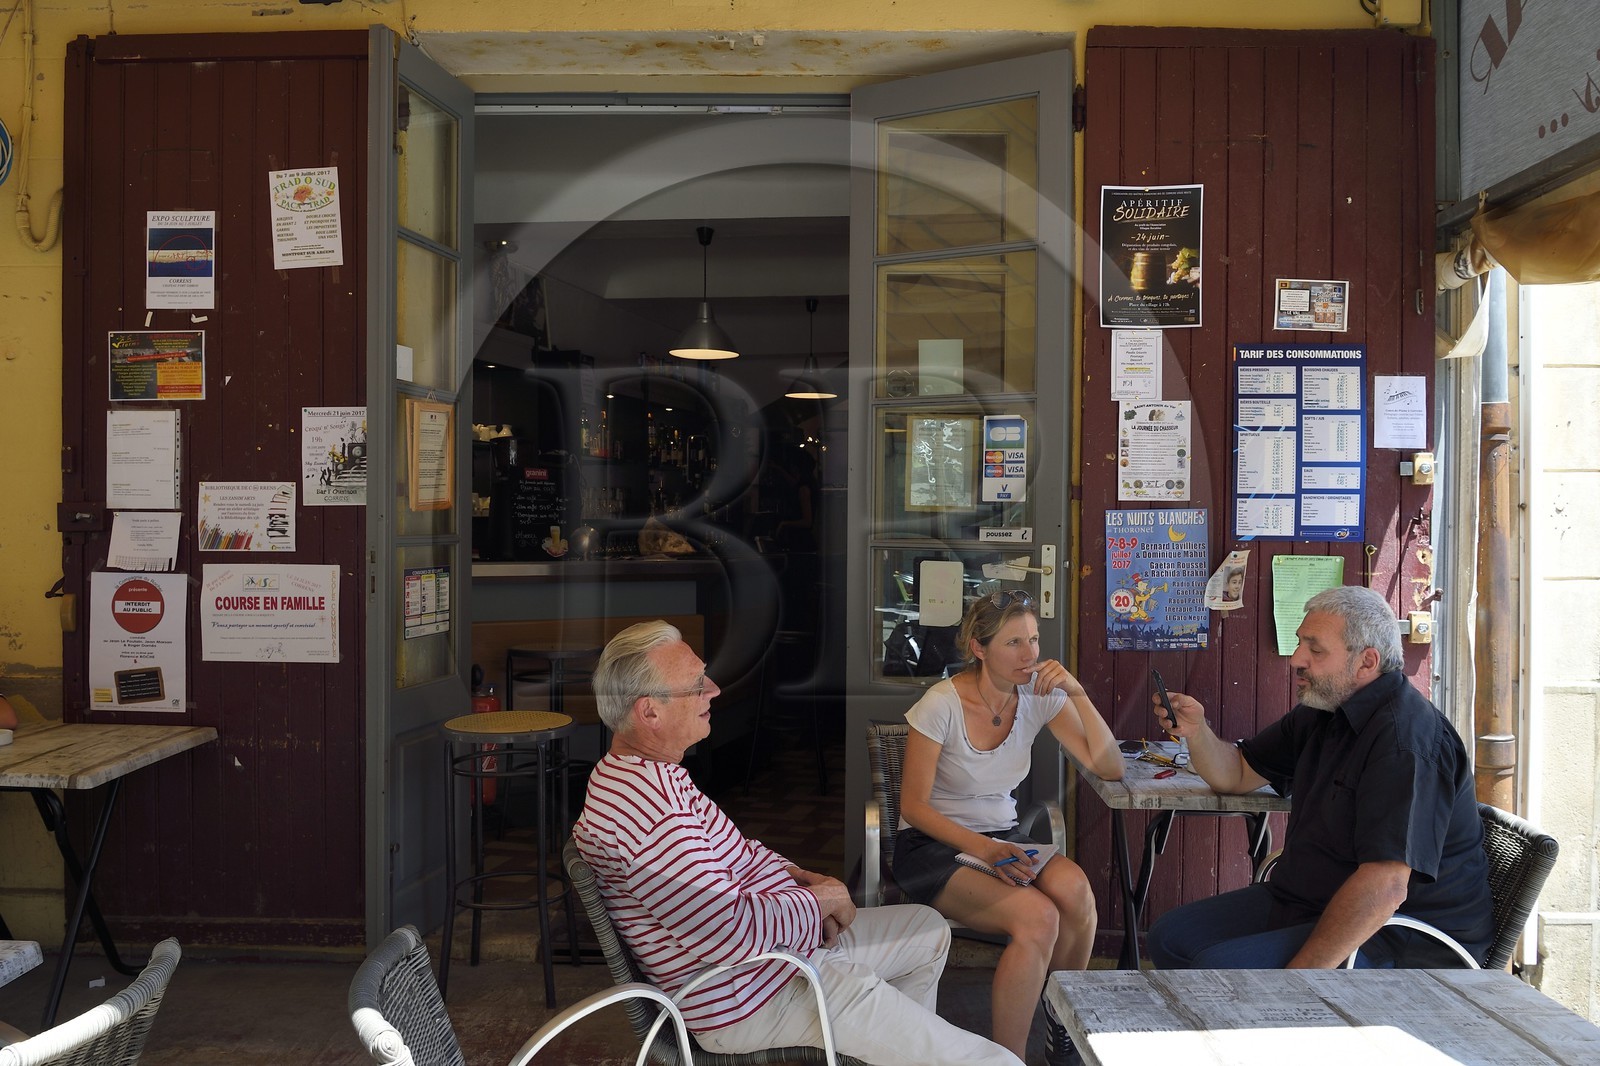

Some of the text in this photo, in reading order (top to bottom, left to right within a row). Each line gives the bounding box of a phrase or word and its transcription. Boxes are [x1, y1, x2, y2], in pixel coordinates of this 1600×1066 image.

[273, 178, 301, 194] TRAD
[315, 177, 336, 190] SUD
[309, 196, 330, 208] TRAD
[1121, 198, 1183, 207] APÉRITIF
[1112, 205, 1190, 222] SOLIDAIRE
[1239, 350, 1362, 359] TARIF DES CONSOMMATIONS
[1001, 484, 1008, 492] V
[1107, 511, 1205, 526] LES NUITS BLANCHES
[1111, 551, 1131, 560] juillet
[1142, 551, 1181, 559] Dominique
[1112, 560, 1131, 569] 2017
[215, 596, 325, 610] COURSE EN FAMILLE
[1114, 595, 1130, 608] 20
